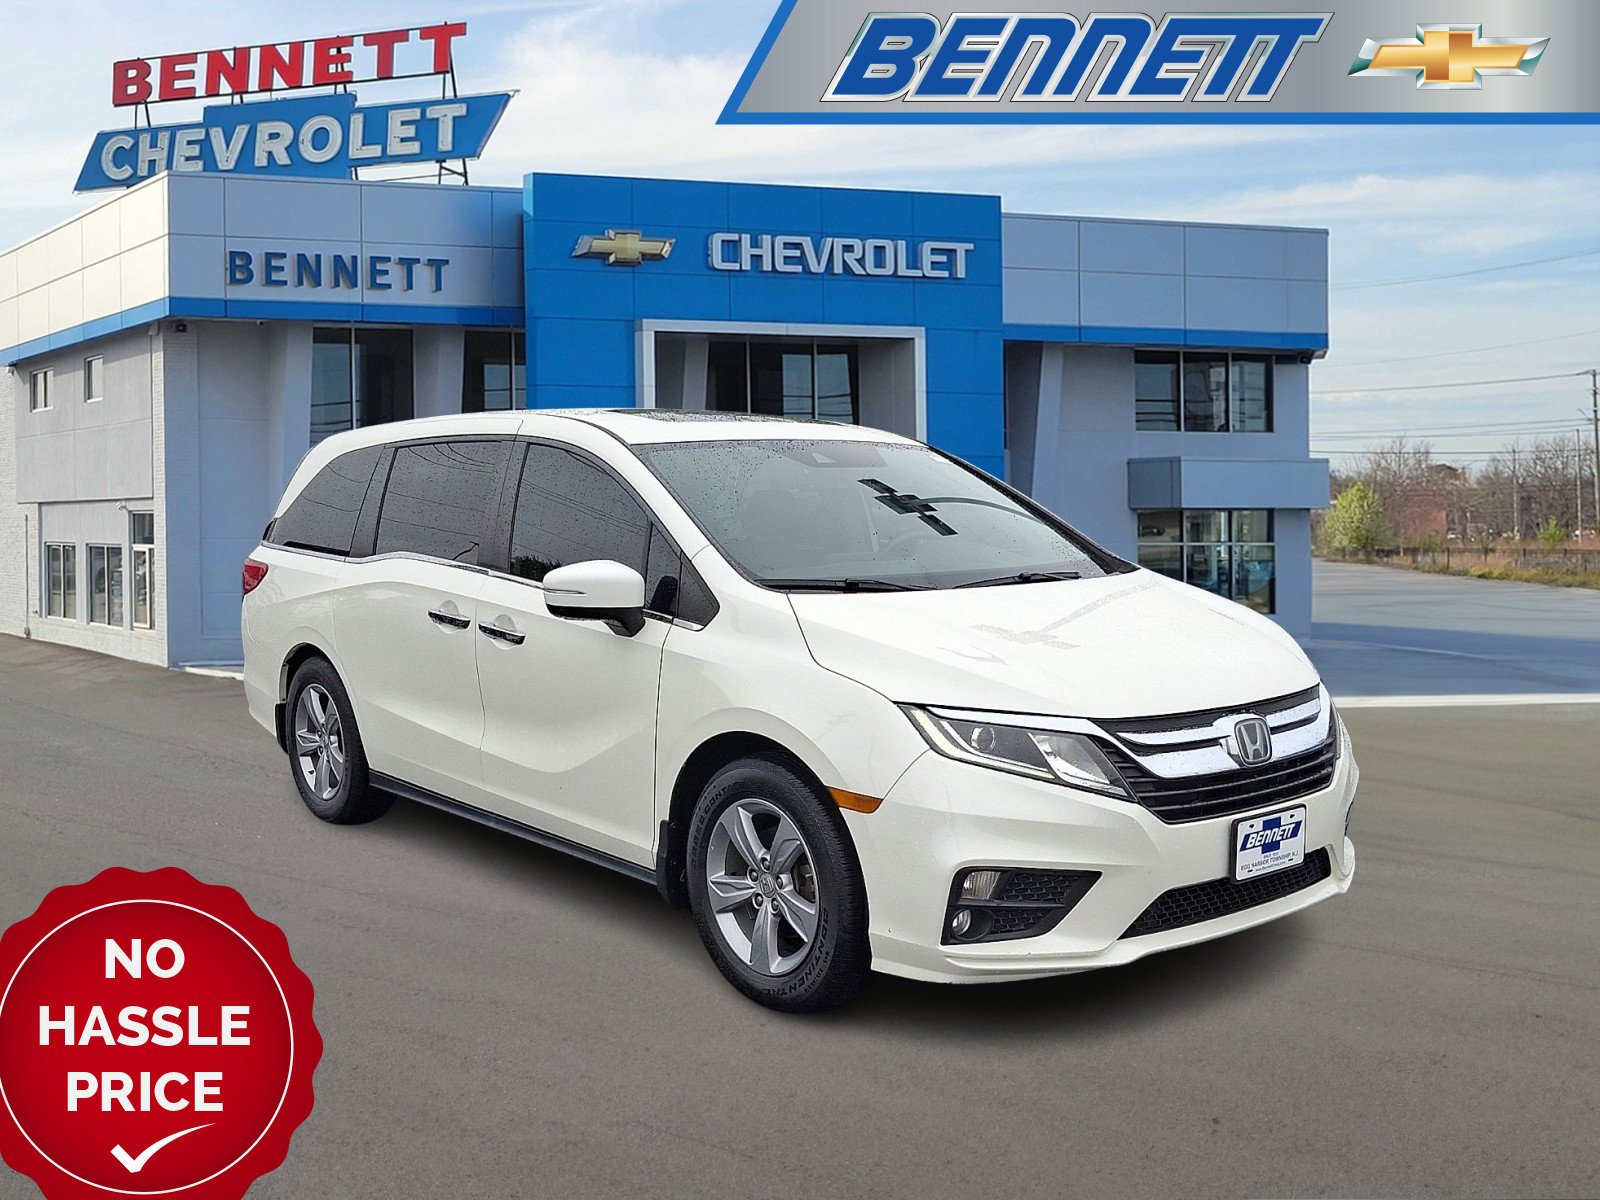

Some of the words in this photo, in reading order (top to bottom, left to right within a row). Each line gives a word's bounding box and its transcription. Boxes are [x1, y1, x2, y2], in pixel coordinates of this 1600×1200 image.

[113, 22, 467, 106] BENNETT
[100, 103, 467, 181] CHEVROLET
[228, 250, 450, 292] BENNETT
[708, 232, 974, 278] CHEVROLET
[1245, 823, 1296, 849] BENNETT
